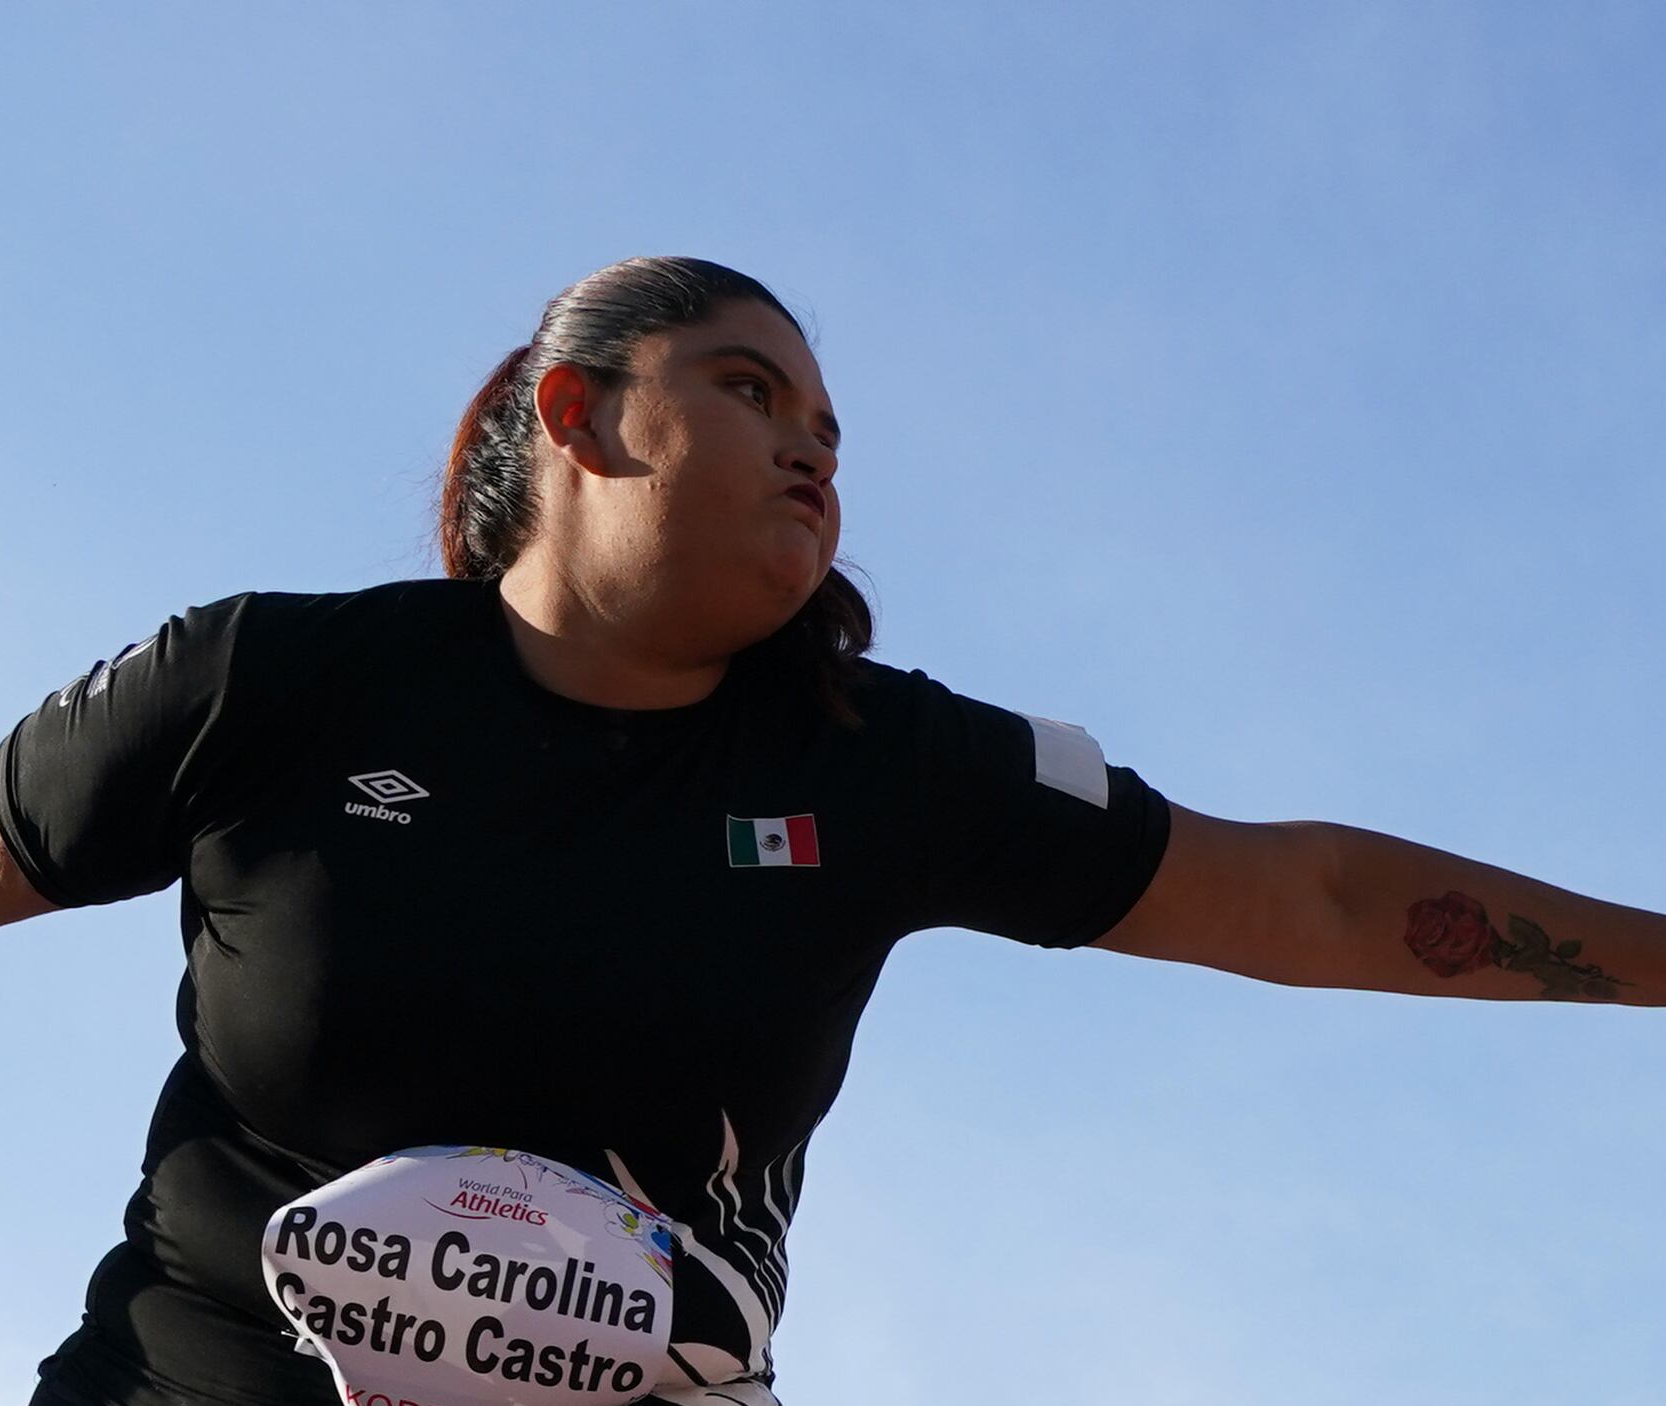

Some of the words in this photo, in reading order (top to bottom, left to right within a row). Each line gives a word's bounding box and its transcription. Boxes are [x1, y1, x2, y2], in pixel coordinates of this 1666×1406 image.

[344, 801, 411, 825] umbro
[459, 1177, 500, 1195] World
[502, 1186, 533, 1203] Para
[450, 1191, 548, 1226] Athletics
[275, 1206, 412, 1281] Rosa
[430, 1231, 656, 1334] Carolina
[275, 1272, 446, 1362] Castro
[465, 1316, 644, 1393] Castro
